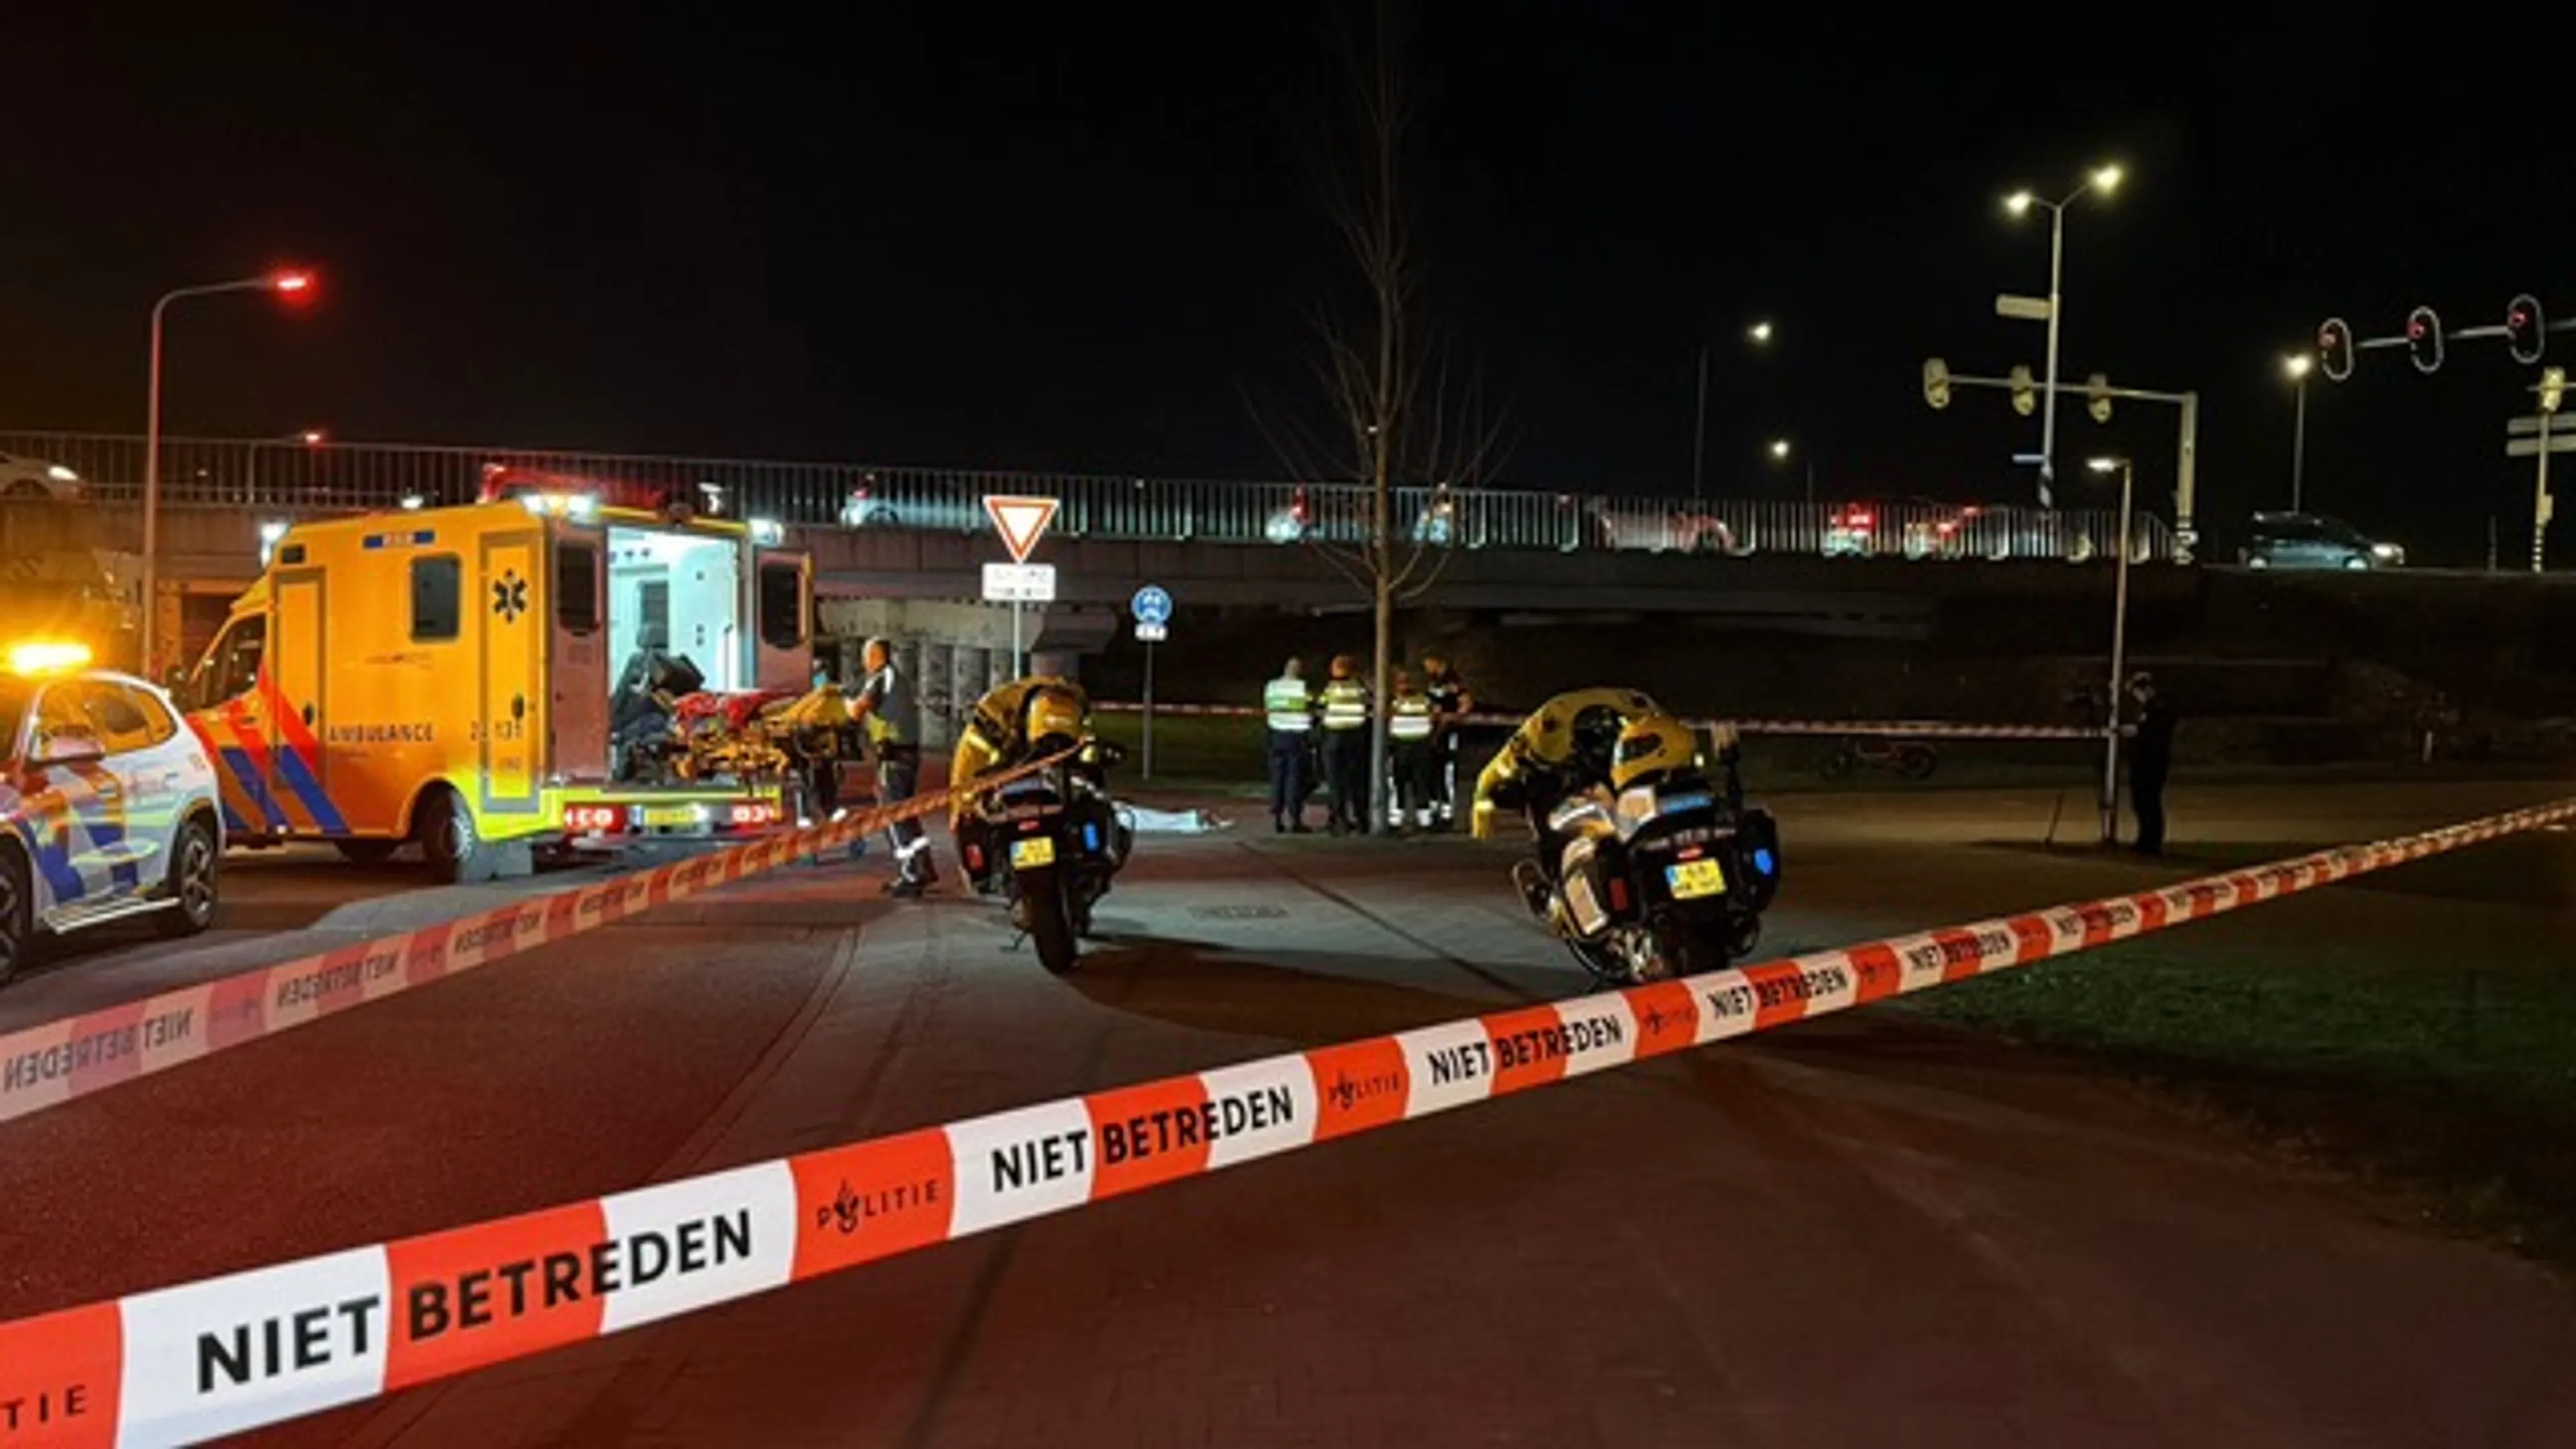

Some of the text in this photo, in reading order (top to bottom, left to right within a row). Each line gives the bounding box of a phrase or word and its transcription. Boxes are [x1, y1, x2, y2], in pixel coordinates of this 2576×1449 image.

[1426, 1041, 1489, 1086] NIET
[1497, 1014, 1622, 1069] BETREDEN
[991, 1085, 1293, 1191] NIET BETREDEN
[197, 1208, 751, 1394] NIET BETREDEN
